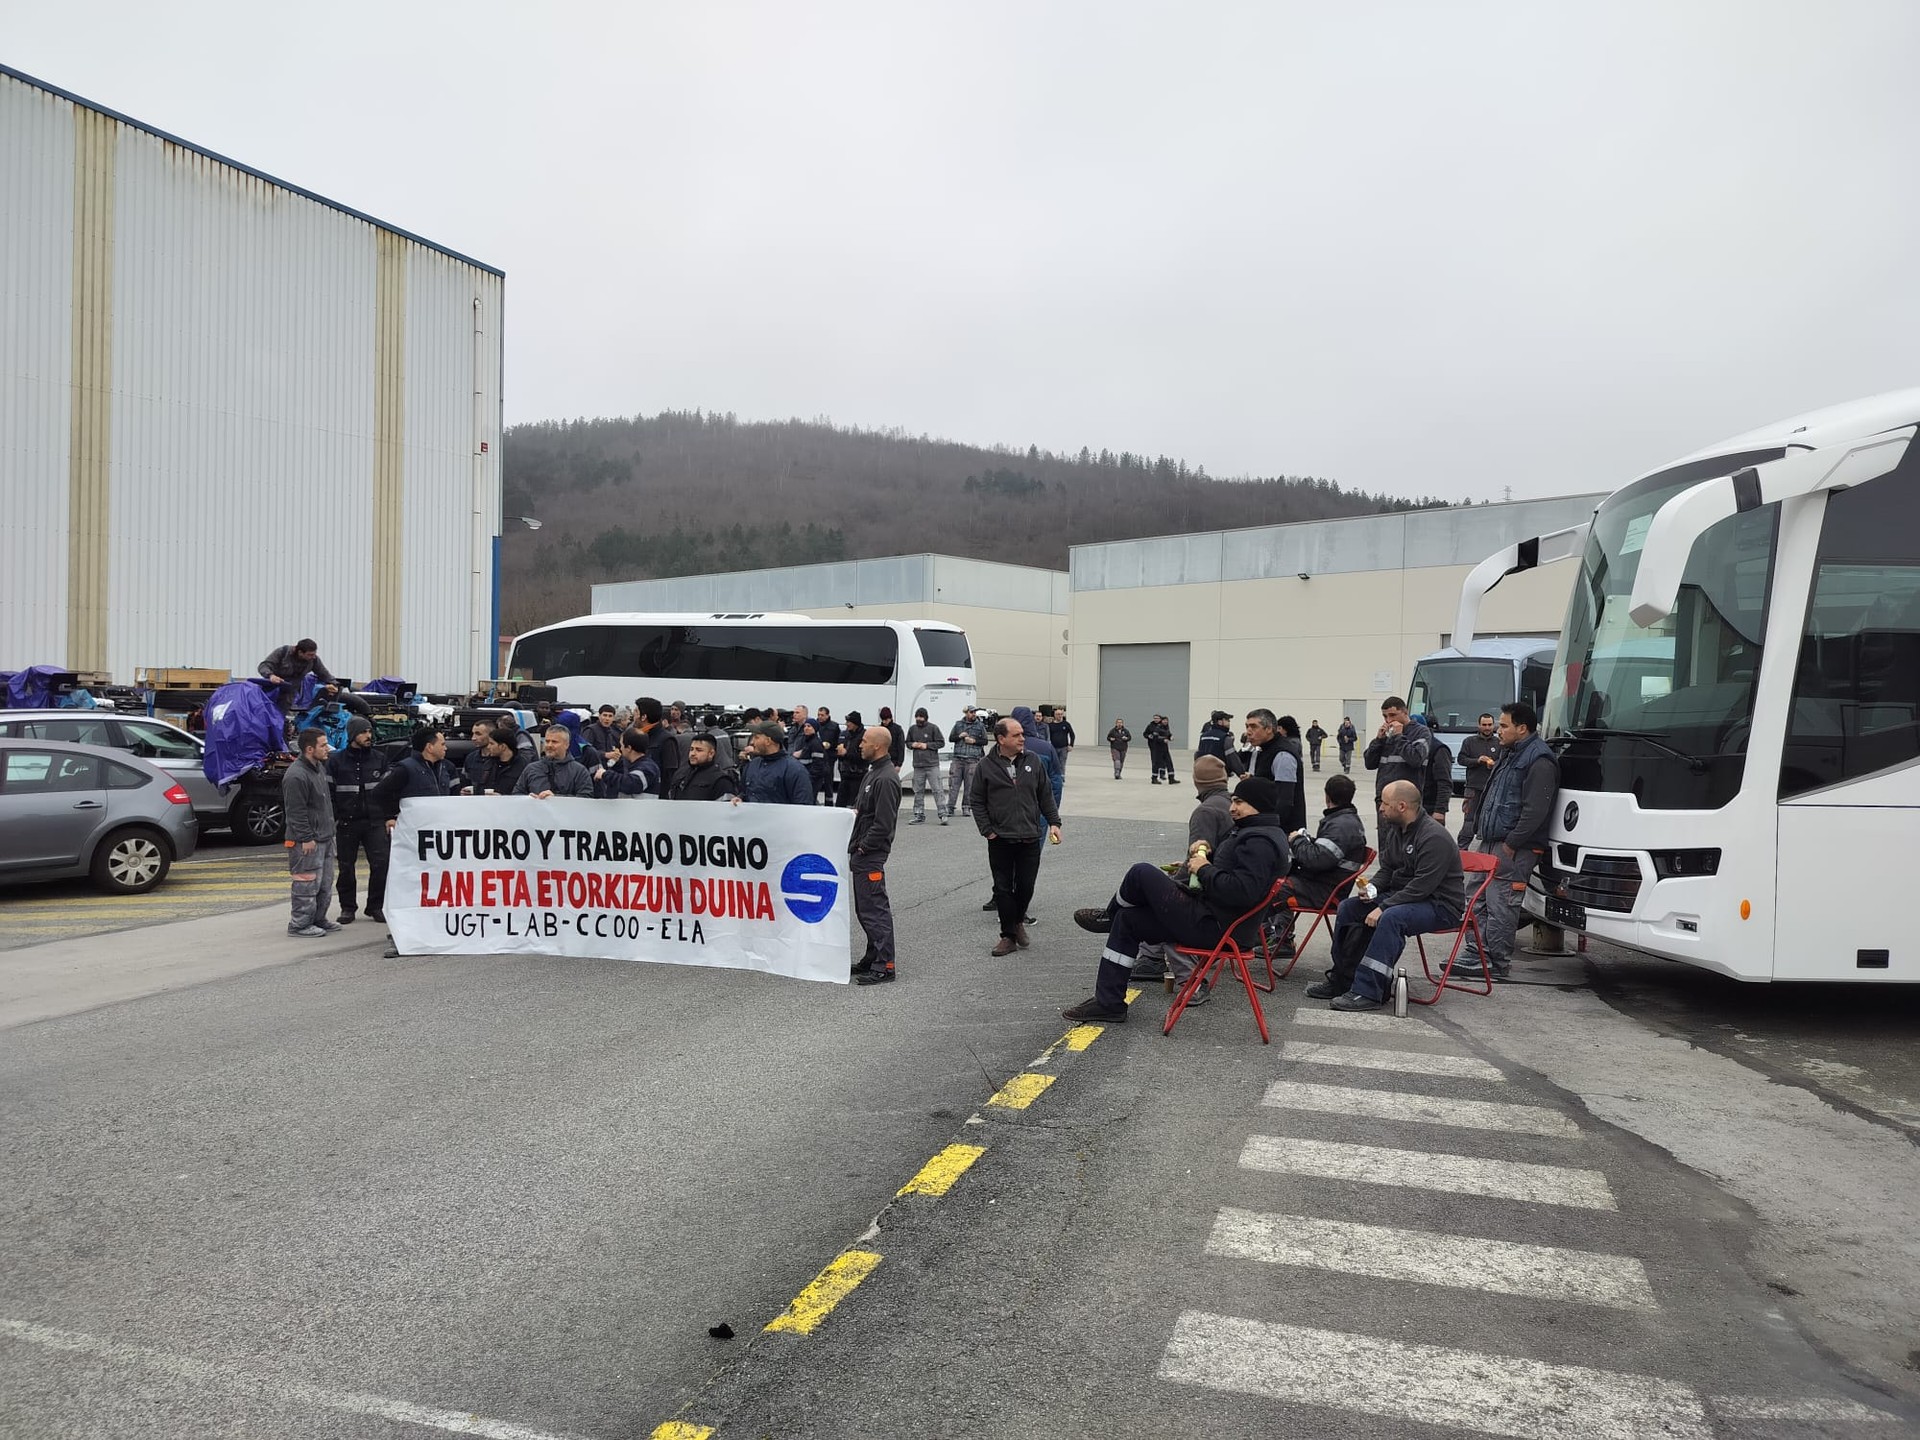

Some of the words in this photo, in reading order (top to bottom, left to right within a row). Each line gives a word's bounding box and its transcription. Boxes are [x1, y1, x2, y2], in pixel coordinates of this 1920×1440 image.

[417, 829, 531, 861] FUTURO
[535, 829, 556, 860] Y
[559, 830, 673, 870] TRABAJO
[679, 834, 768, 870] DIGNO
[420, 871, 474, 907] LAN
[481, 870, 532, 907] ETA
[537, 870, 683, 913] ETORKIZUN
[690, 877, 775, 921] DUINA
